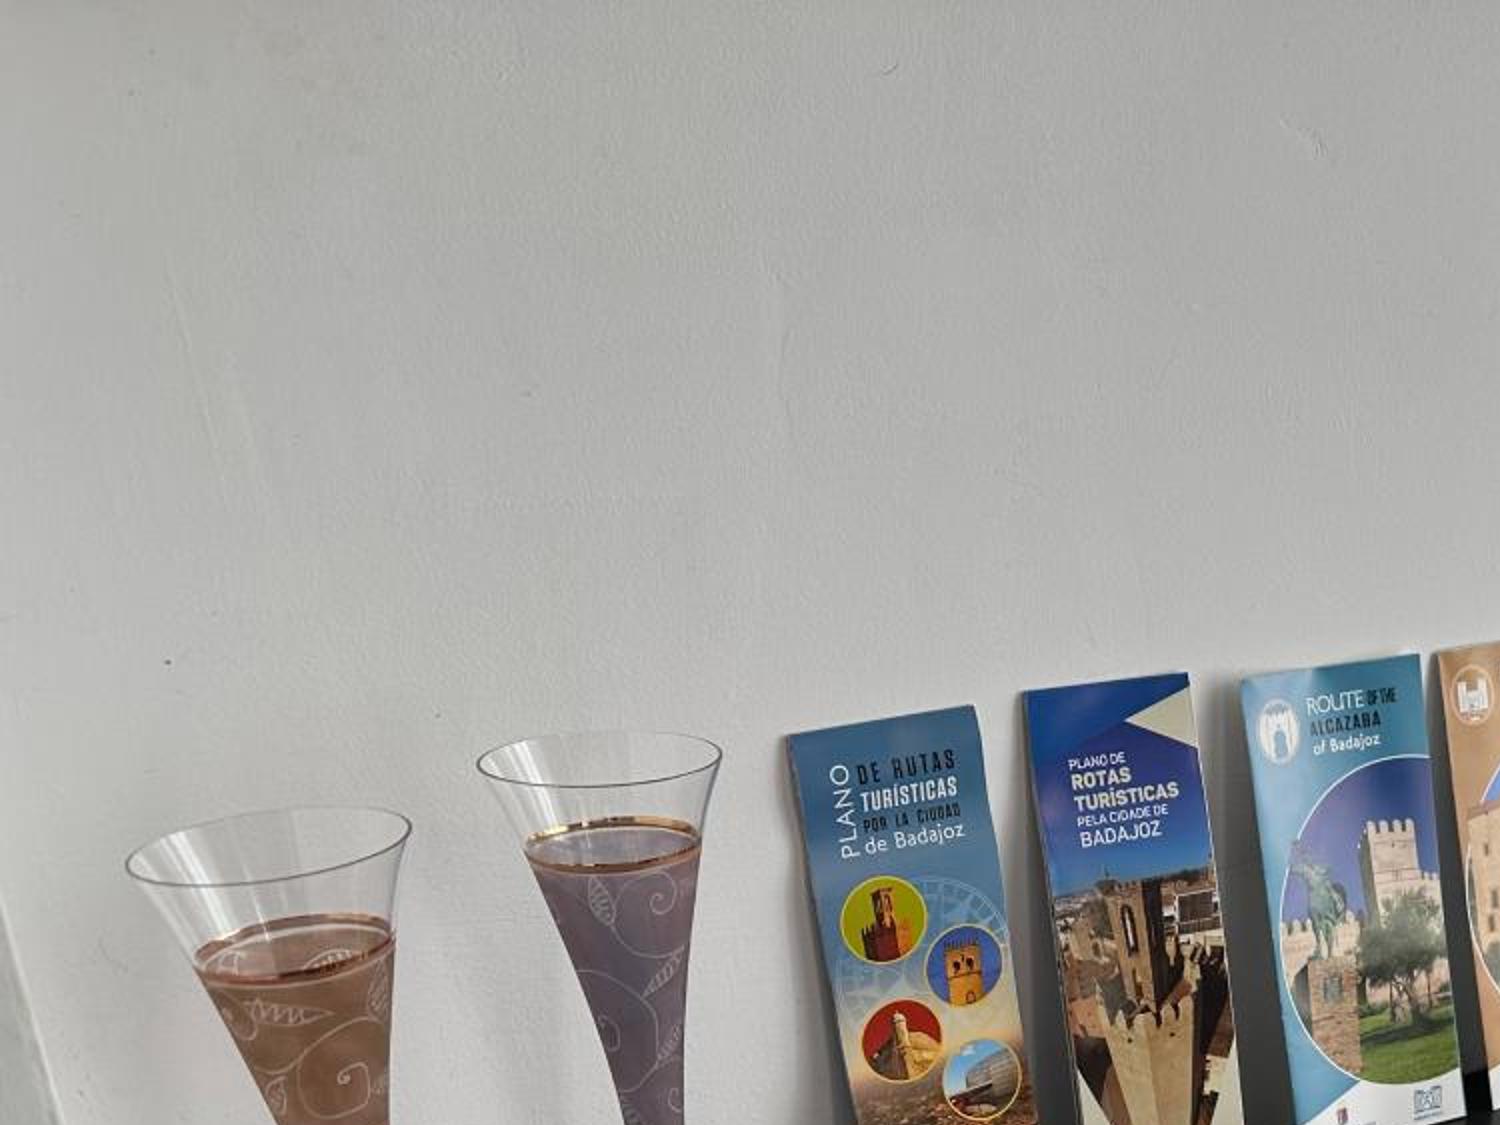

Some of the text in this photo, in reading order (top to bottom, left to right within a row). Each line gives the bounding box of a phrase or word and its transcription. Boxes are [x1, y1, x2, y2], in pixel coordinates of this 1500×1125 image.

[1305, 689, 1365, 716] ROUTE
[1309, 711, 1381, 737] ALCAZABA
[1313, 733, 1381, 755] of Badajoz
[857, 749, 955, 785] DE RUTAS
[1068, 751, 1126, 771] PLANO DE
[1071, 767, 1132, 791] ROTAS
[860, 776, 958, 812] TURÍSTICAS
[1074, 781, 1180, 812] TURÍSTICAS
[830, 765, 860, 859] PLANO
[864, 802, 961, 834] POR LA CIUDAD
[1077, 803, 1169, 828] PELA CIDADE DE
[865, 823, 966, 855] de Badajoz
[1080, 820, 1163, 848] BADAJOZ
